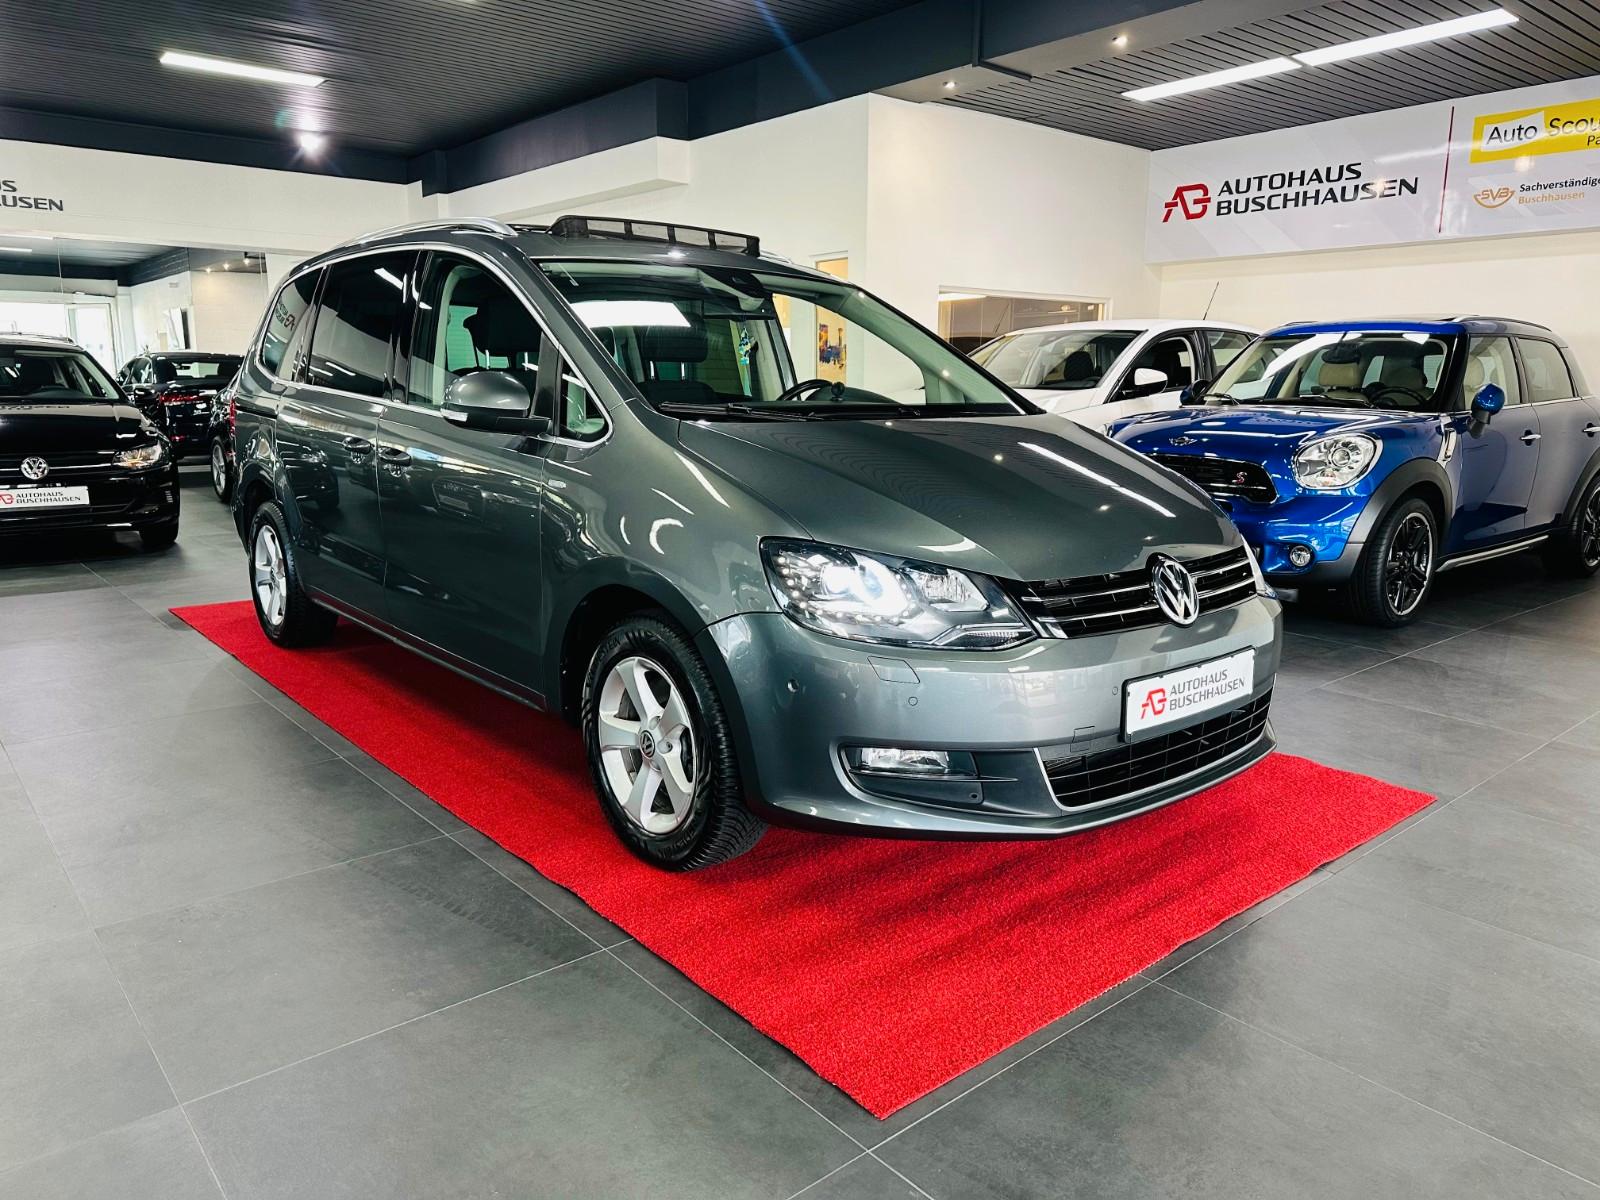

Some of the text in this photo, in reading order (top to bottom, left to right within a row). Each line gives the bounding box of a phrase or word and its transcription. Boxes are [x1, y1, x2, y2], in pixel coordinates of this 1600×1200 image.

[1486, 124, 1538, 145] Auto
[0, 179, 17, 193] S
[1217, 162, 1362, 196] AUTOHAUS
[0, 194, 64, 212] USEN
[1216, 177, 1418, 216] BUSCHHAUSEN
[1518, 191, 1585, 205] Buschhausen
[16, 491, 64, 499] AUTOHAUS
[1169, 668, 1229, 697] AUTOHAUS
[1169, 677, 1245, 712] BUSCHHAUSEN
